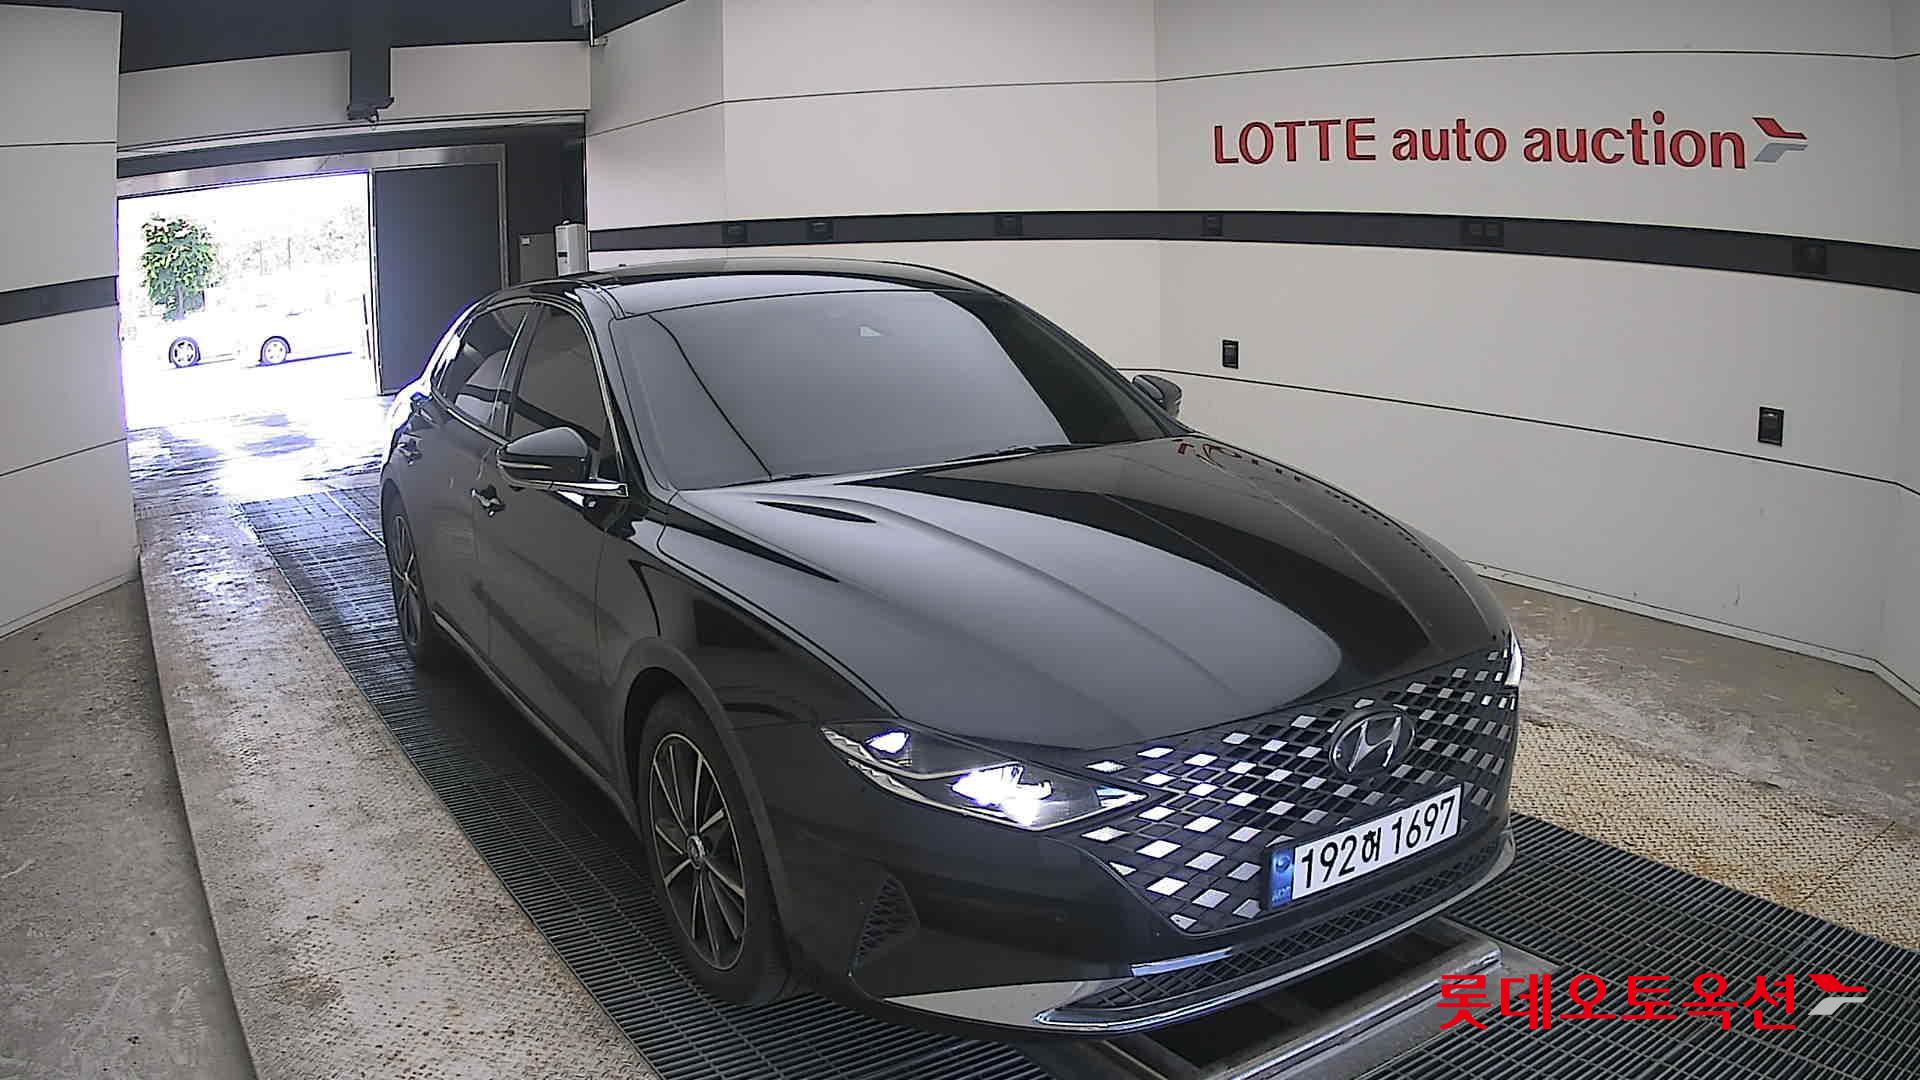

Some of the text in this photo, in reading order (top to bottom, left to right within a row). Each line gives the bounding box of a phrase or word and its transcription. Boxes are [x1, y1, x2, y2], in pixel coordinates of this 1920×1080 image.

[1213, 110, 1747, 169] LOTTE auto auction
[1301, 796, 1456, 889] 192허 1697
